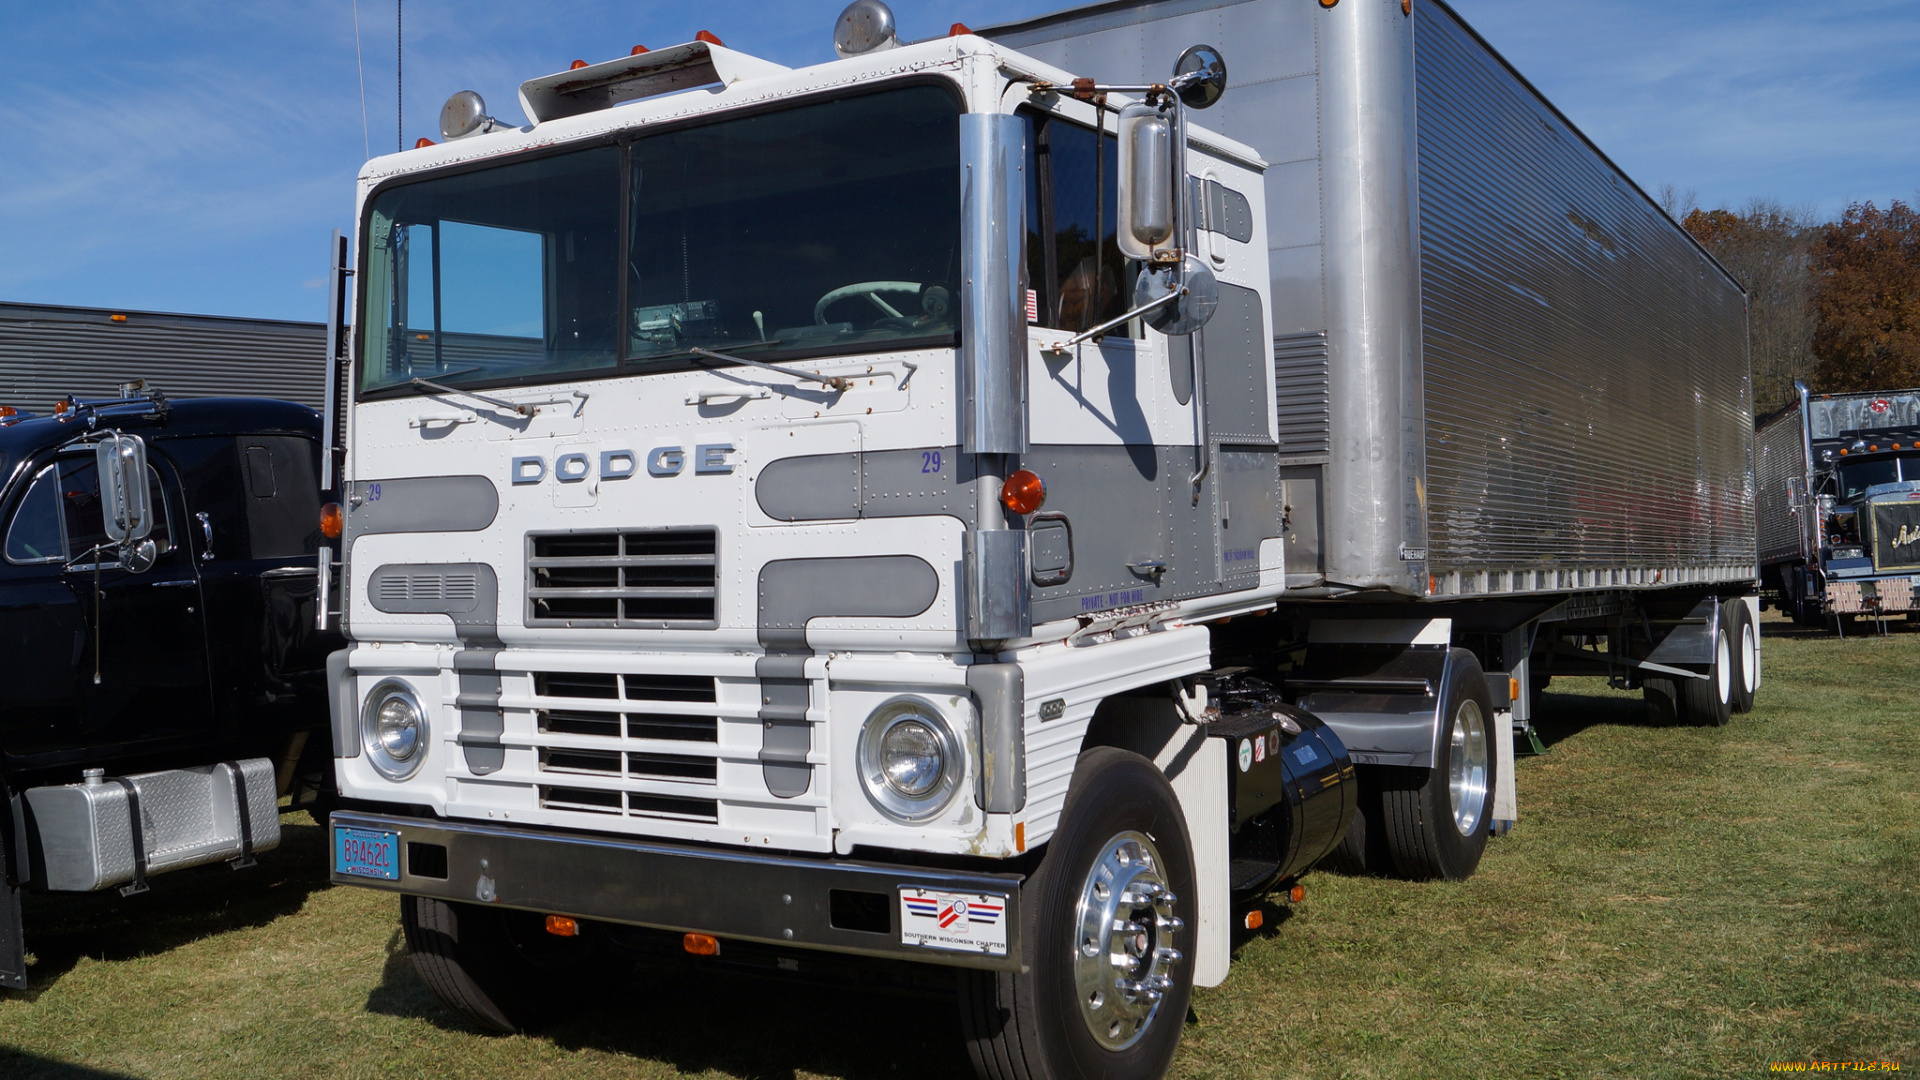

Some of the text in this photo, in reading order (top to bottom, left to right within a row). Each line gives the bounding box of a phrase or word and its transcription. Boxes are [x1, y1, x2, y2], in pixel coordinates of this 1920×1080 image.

[512, 443, 737, 486] DODGE
[922, 451, 941, 473] 29
[369, 483, 381, 501] 29
[1081, 595, 1103, 610] PRIVATE
[1109, 592, 1119, 606] NOT
[1120, 591, 1130, 604] FOR
[1132, 589, 1143, 602] HIRE
[344, 839, 390, 867] 89462C
[352, 866, 383, 875] WISCONSIN
[904, 932, 1006, 949] SOUTHERN WISCONSIN CHAPTER
